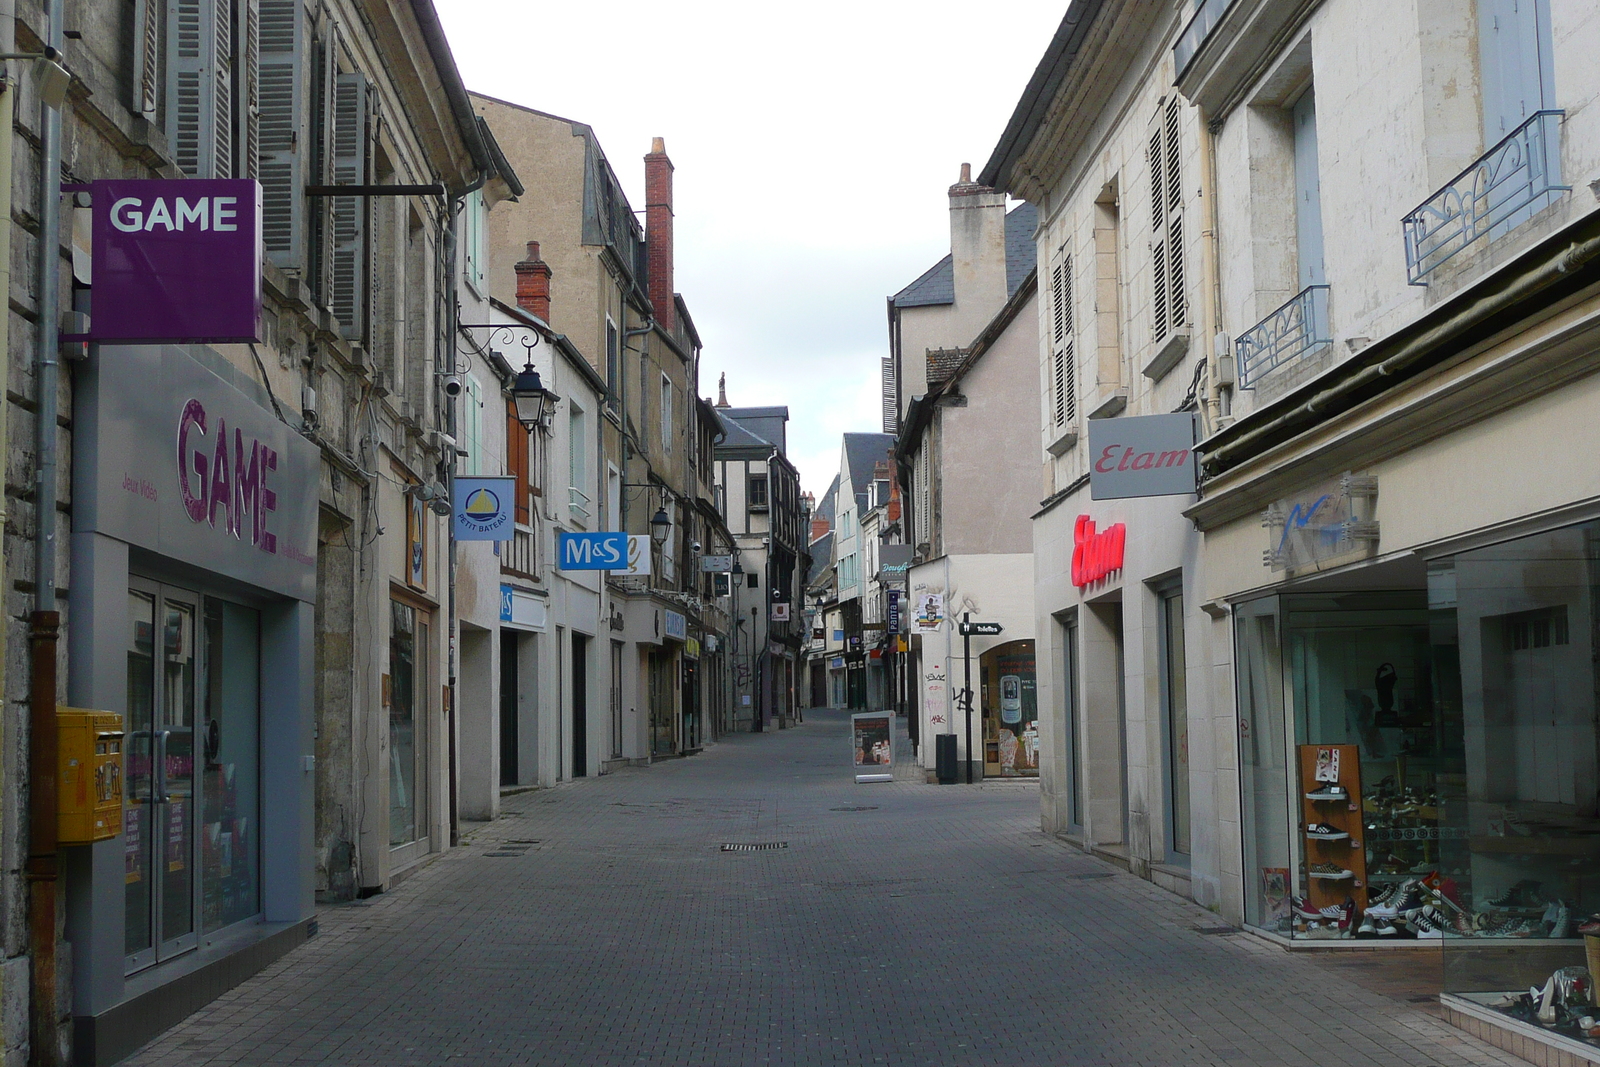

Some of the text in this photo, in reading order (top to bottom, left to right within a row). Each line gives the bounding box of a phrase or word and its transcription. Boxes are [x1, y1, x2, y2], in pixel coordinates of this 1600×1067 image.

[110, 196, 238, 232] GAME
[1094, 443, 1189, 474] Etam
[122, 472, 158, 503] Jeux Vidéo
[176, 397, 278, 555] GAME
[457, 512, 508, 533] PETIT BATEAU
[566, 537, 622, 564] M&S
[1332, 749, 1340, 780] VANS
